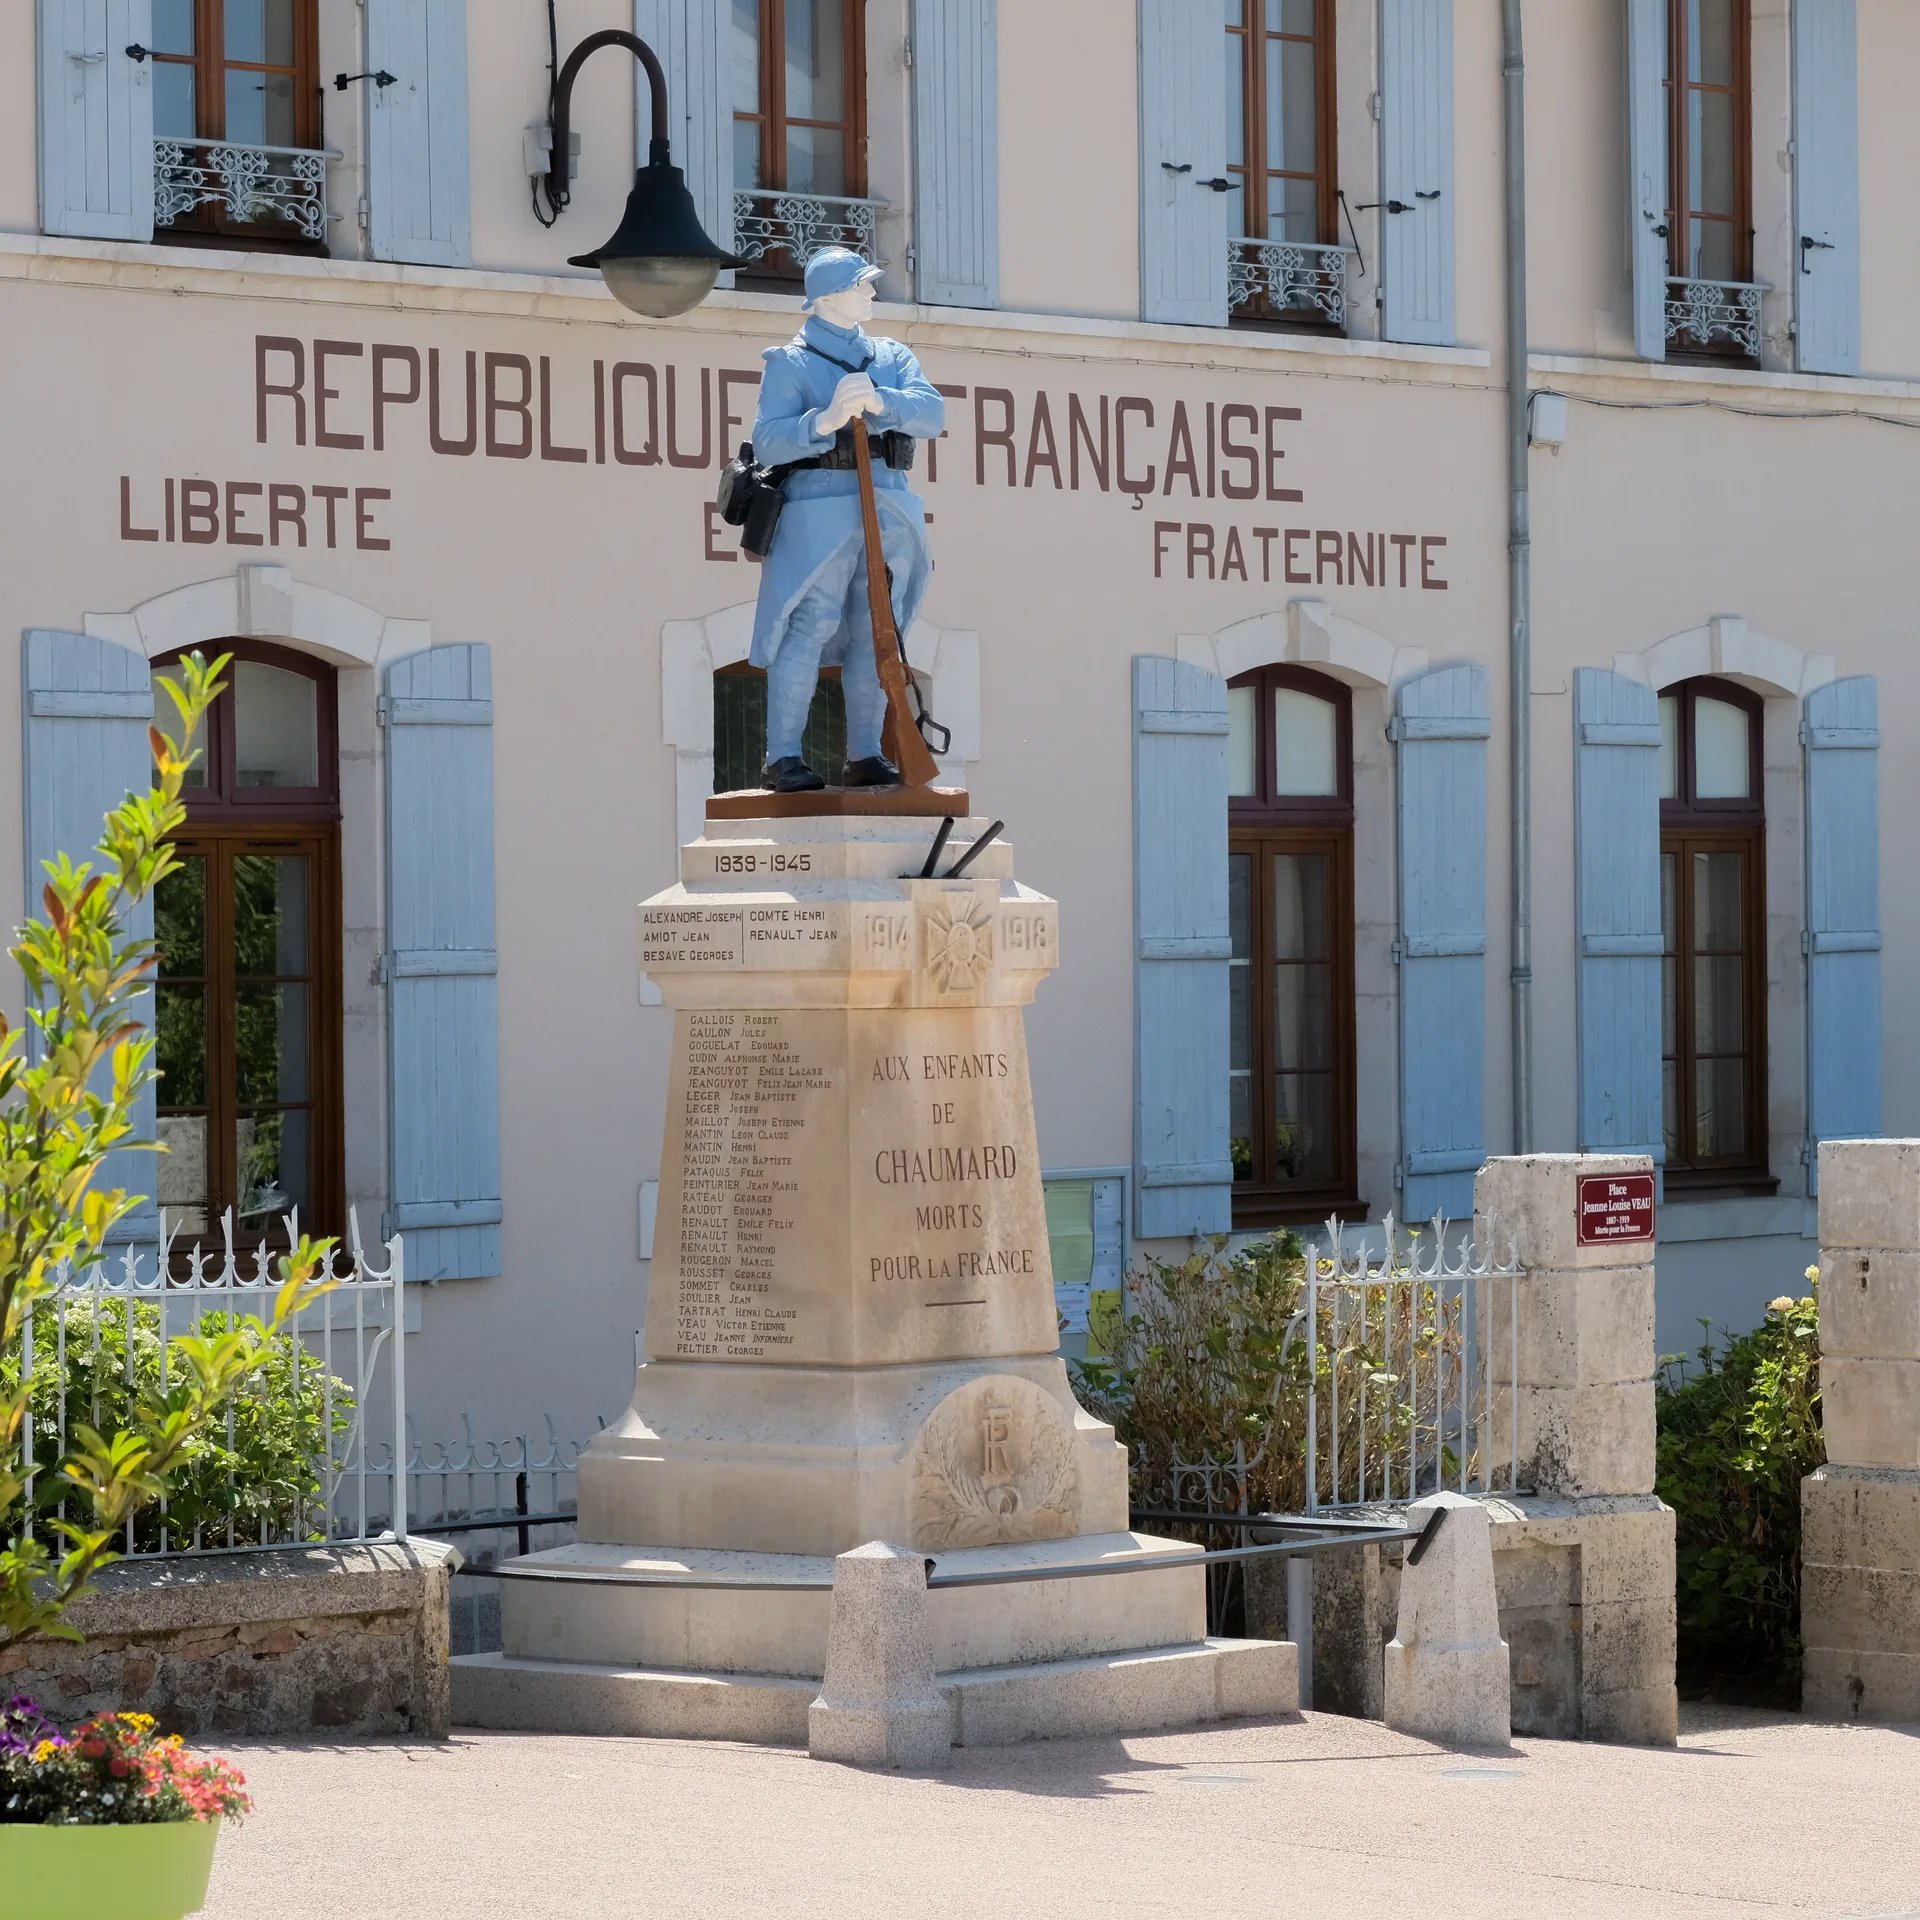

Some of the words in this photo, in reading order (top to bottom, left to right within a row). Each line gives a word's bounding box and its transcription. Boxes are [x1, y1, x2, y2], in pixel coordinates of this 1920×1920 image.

[255, 334, 763, 471] REPUBLIQUE
[120, 475, 391, 552] LIBERTE
[1155, 521, 1448, 591] FRATERNITE
[715, 855, 811, 873] 1939-1945
[643, 912, 703, 923] ALEXANDRE
[750, 911, 789, 921] COMTE
[643, 932, 677, 942] AMIOT
[750, 930, 803, 941] RENAULT
[866, 916, 910, 951] 1914
[1002, 916, 1046, 951] 1918
[644, 951, 685, 961] BESAVE
[690, 1016, 734, 1025] GALLOIS
[690, 1028, 731, 1038] GAULON
[689, 1041, 740, 1050] GOGUELAT
[689, 1054, 717, 1063] GUDIN
[688, 1066, 748, 1076] JEANGUYOT
[872, 1056, 910, 1081] AUX
[923, 1054, 1008, 1079] ENFANTS
[688, 1079, 748, 1089] JEANGUYOT
[686, 1092, 720, 1101] LEGER
[686, 1104, 720, 1114] LEGER
[932, 1103, 954, 1124] DE
[685, 1117, 729, 1126] MAILLOT
[685, 1130, 723, 1139] MANTIN
[684, 1142, 723, 1152] MANTIN
[684, 1155, 721, 1164] NAUDIN
[875, 1146, 1016, 1184] CHAUMARD
[684, 1168, 730, 1178] PATAQUIS
[683, 1180, 740, 1189] PEINTURIER
[1609, 1183, 1627, 1196] Place
[683, 1193, 724, 1202] RATEAU
[682, 1205, 723, 1214] RAUDOT
[1583, 1202, 1607, 1215] Jeanne
[1609, 1198, 1631, 1211] Louise
[1631, 1197, 1651, 1209] VEAU
[916, 1204, 983, 1230] MORTS
[682, 1218, 728, 1228] RENAULT
[1595, 1226, 1608, 1234] Morte
[1609, 1227, 1620, 1235] pour
[1620, 1225, 1625, 1233] la
[681, 1231, 727, 1240] RENAULT
[681, 1243, 727, 1252] RENAULT
[681, 1256, 731, 1265] ROUGERON
[870, 1255, 922, 1282] POUR
[928, 1258, 951, 1278] LA
[957, 1250, 1034, 1277] FRANCE
[680, 1269, 725, 1278] ROUSSET
[680, 1281, 719, 1290] SOMMET
[679, 1294, 721, 1303] SOULIER
[679, 1306, 726, 1316] TARTRAT
[678, 1319, 707, 1328] VEAU
[678, 1332, 706, 1341] VEAU
[677, 1344, 718, 1353] PELTIER
